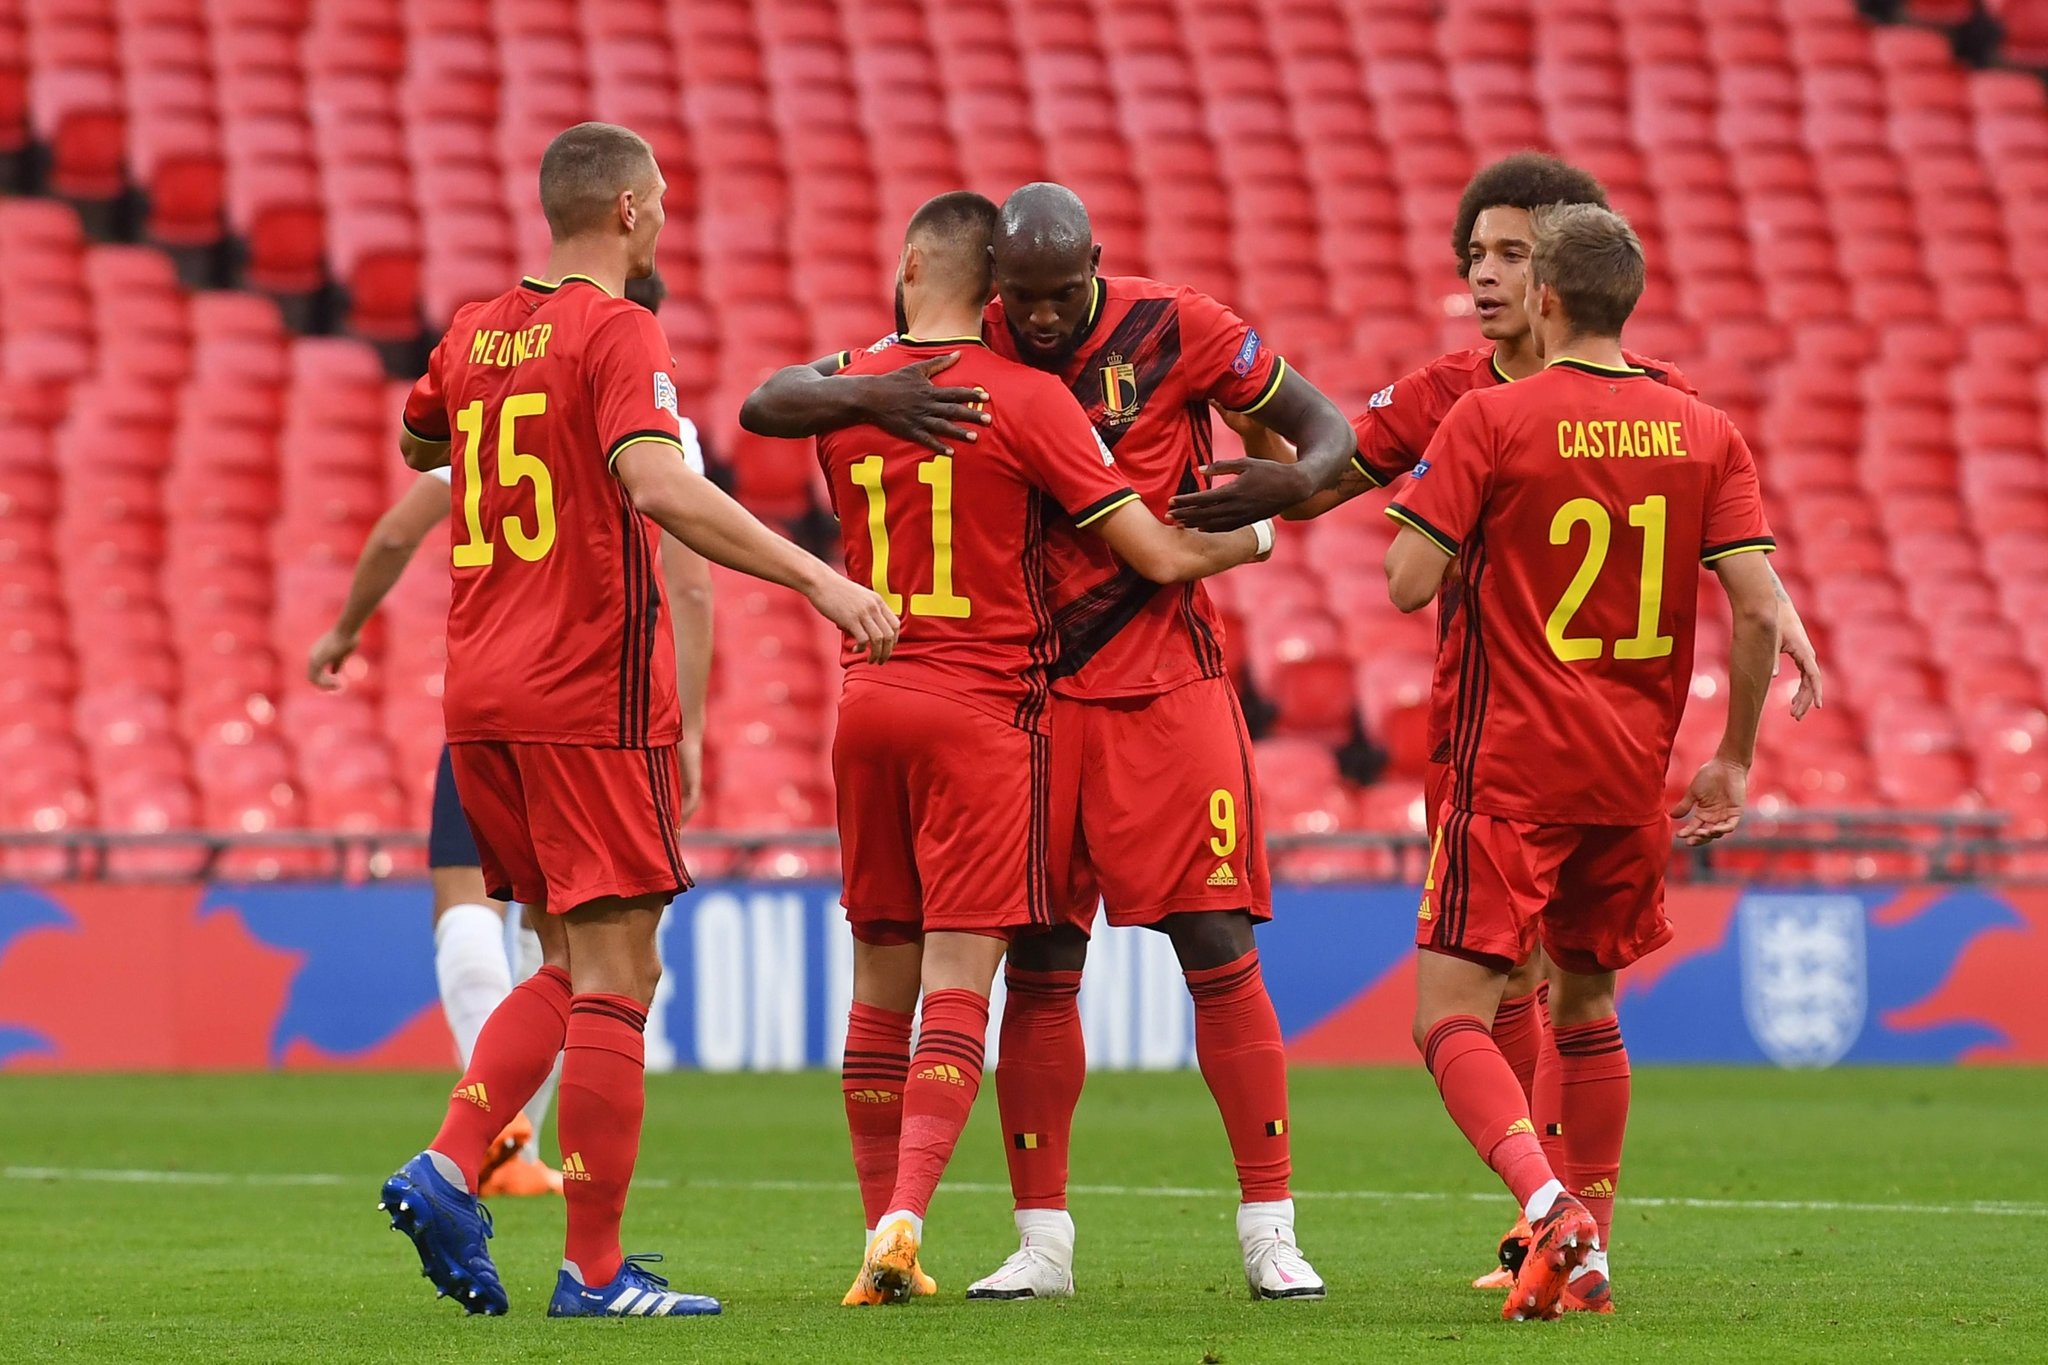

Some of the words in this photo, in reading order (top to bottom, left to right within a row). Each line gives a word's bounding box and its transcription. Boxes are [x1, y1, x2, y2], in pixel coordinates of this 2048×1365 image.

[468, 323, 553, 367] MEUNER
[1557, 420, 1687, 458] CASTAGNE
[452, 392, 556, 567] 15
[850, 455, 971, 619] 11
[1545, 494, 1674, 662] 21
[1209, 788, 1237, 857] 9
[1206, 877, 1239, 886] adidas
[850, 1091, 899, 1103] adidas
[917, 1072, 966, 1087] adidas
[452, 1092, 491, 1112] adidas
